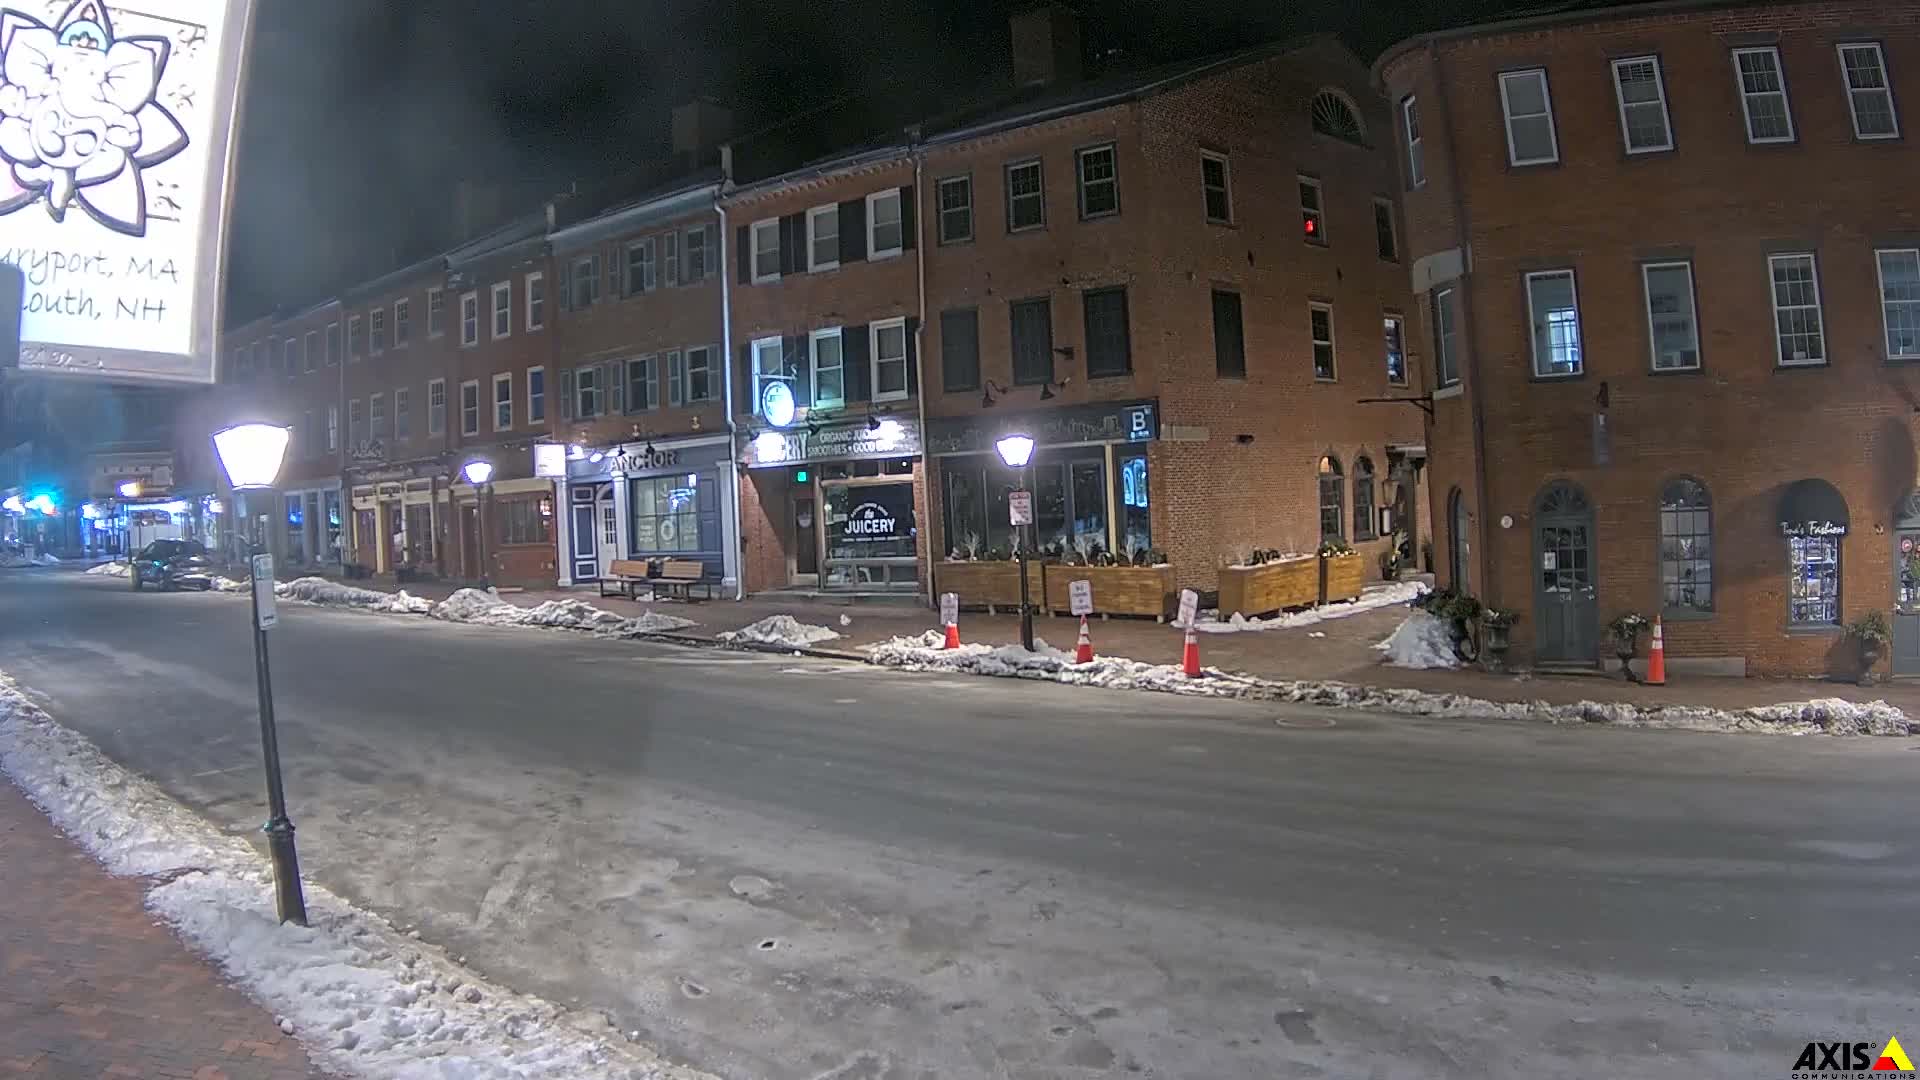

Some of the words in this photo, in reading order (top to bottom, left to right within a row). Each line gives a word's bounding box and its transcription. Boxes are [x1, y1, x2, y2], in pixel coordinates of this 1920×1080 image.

[127, 256, 178, 284] MA
[23, 288, 101, 321] outh,
[116, 296, 167, 323] NH
[819, 430, 851, 443] ORGANIC
[610, 450, 681, 473] ANCHOR
[844, 517, 896, 534] JUICERY
